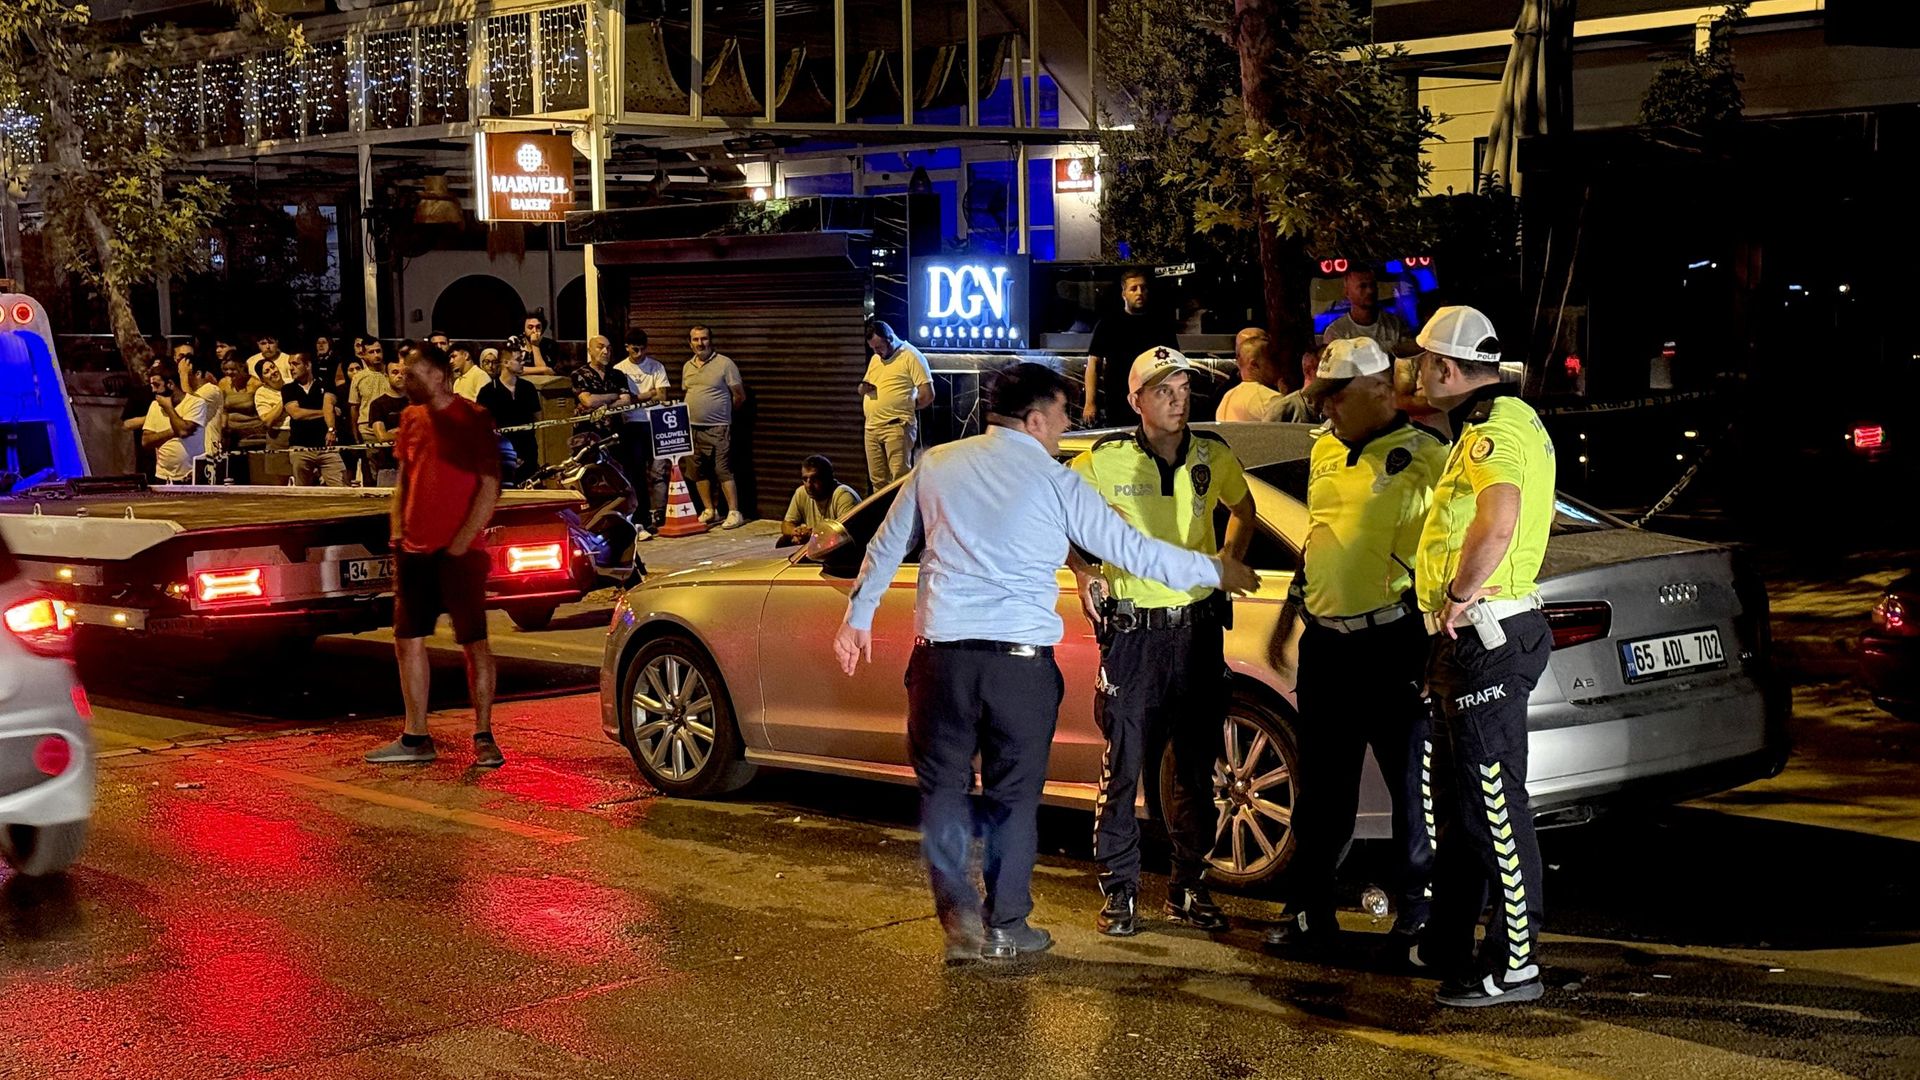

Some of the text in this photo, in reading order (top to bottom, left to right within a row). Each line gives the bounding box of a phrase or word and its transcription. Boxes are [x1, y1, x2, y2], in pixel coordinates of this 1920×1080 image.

[510, 198, 552, 211] BAKERY
[927, 265, 1008, 320] DGN
[919, 325, 1019, 340] GALLERIA
[655, 430, 689, 440] COLDWELL
[660, 437, 686, 447] BANKER
[351, 562, 368, 580] 34
[1633, 643, 1655, 672] 65
[1661, 638, 1691, 668] ADL
[1693, 632, 1722, 662] 702
